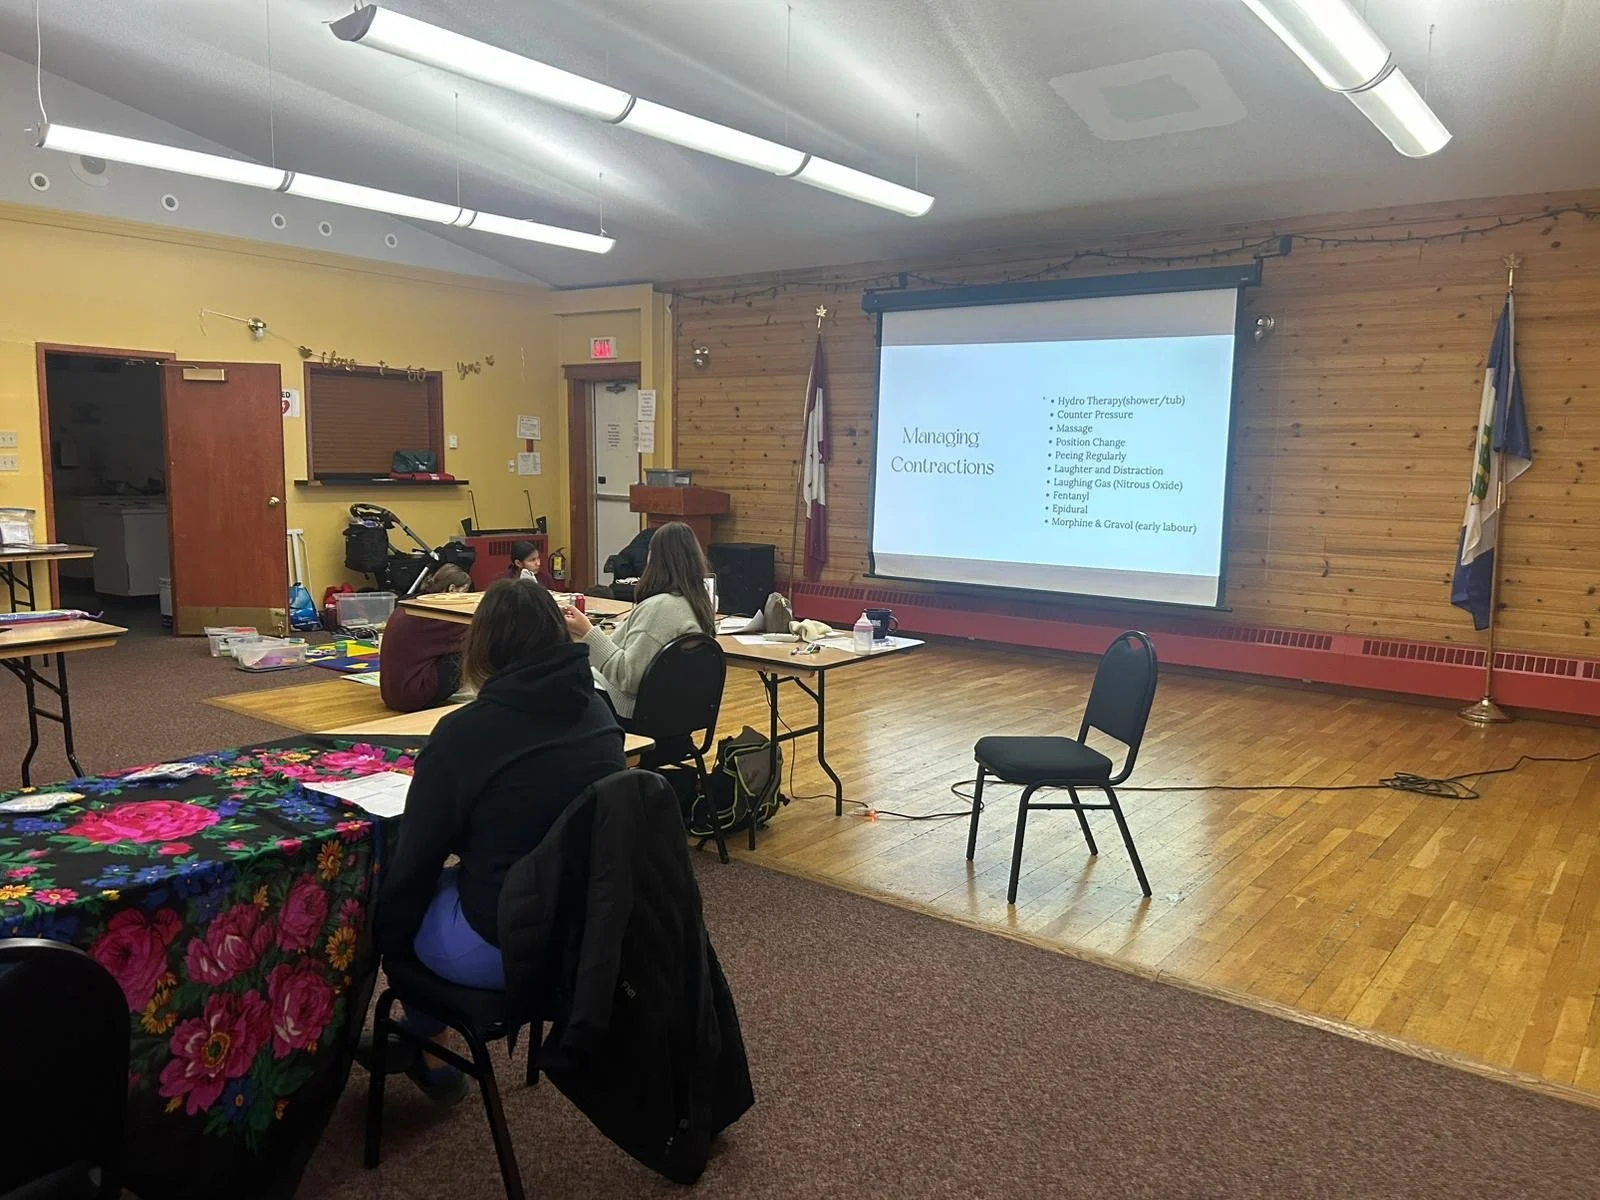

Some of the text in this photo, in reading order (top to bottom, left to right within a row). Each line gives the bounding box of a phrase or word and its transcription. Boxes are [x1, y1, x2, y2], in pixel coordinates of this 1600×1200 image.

[1058, 396, 1085, 408] Hydro
[1058, 410, 1134, 420] Counter Pressure
[1056, 424, 1093, 436] Massage
[903, 427, 980, 448] Managing
[1056, 437, 1126, 450] Position Change
[1055, 451, 1127, 464] Peeing Regularly
[891, 456, 994, 475] Contractions
[1054, 464, 1164, 476] Laughter and Distraction
[1054, 477, 1184, 493] Laughing Gas (Nitrous Oxide)
[1053, 490, 1090, 503] Fentanyl
[1052, 504, 1088, 515] Epidural
[1052, 517, 1198, 536] Morphine & Gravol (early labour)
